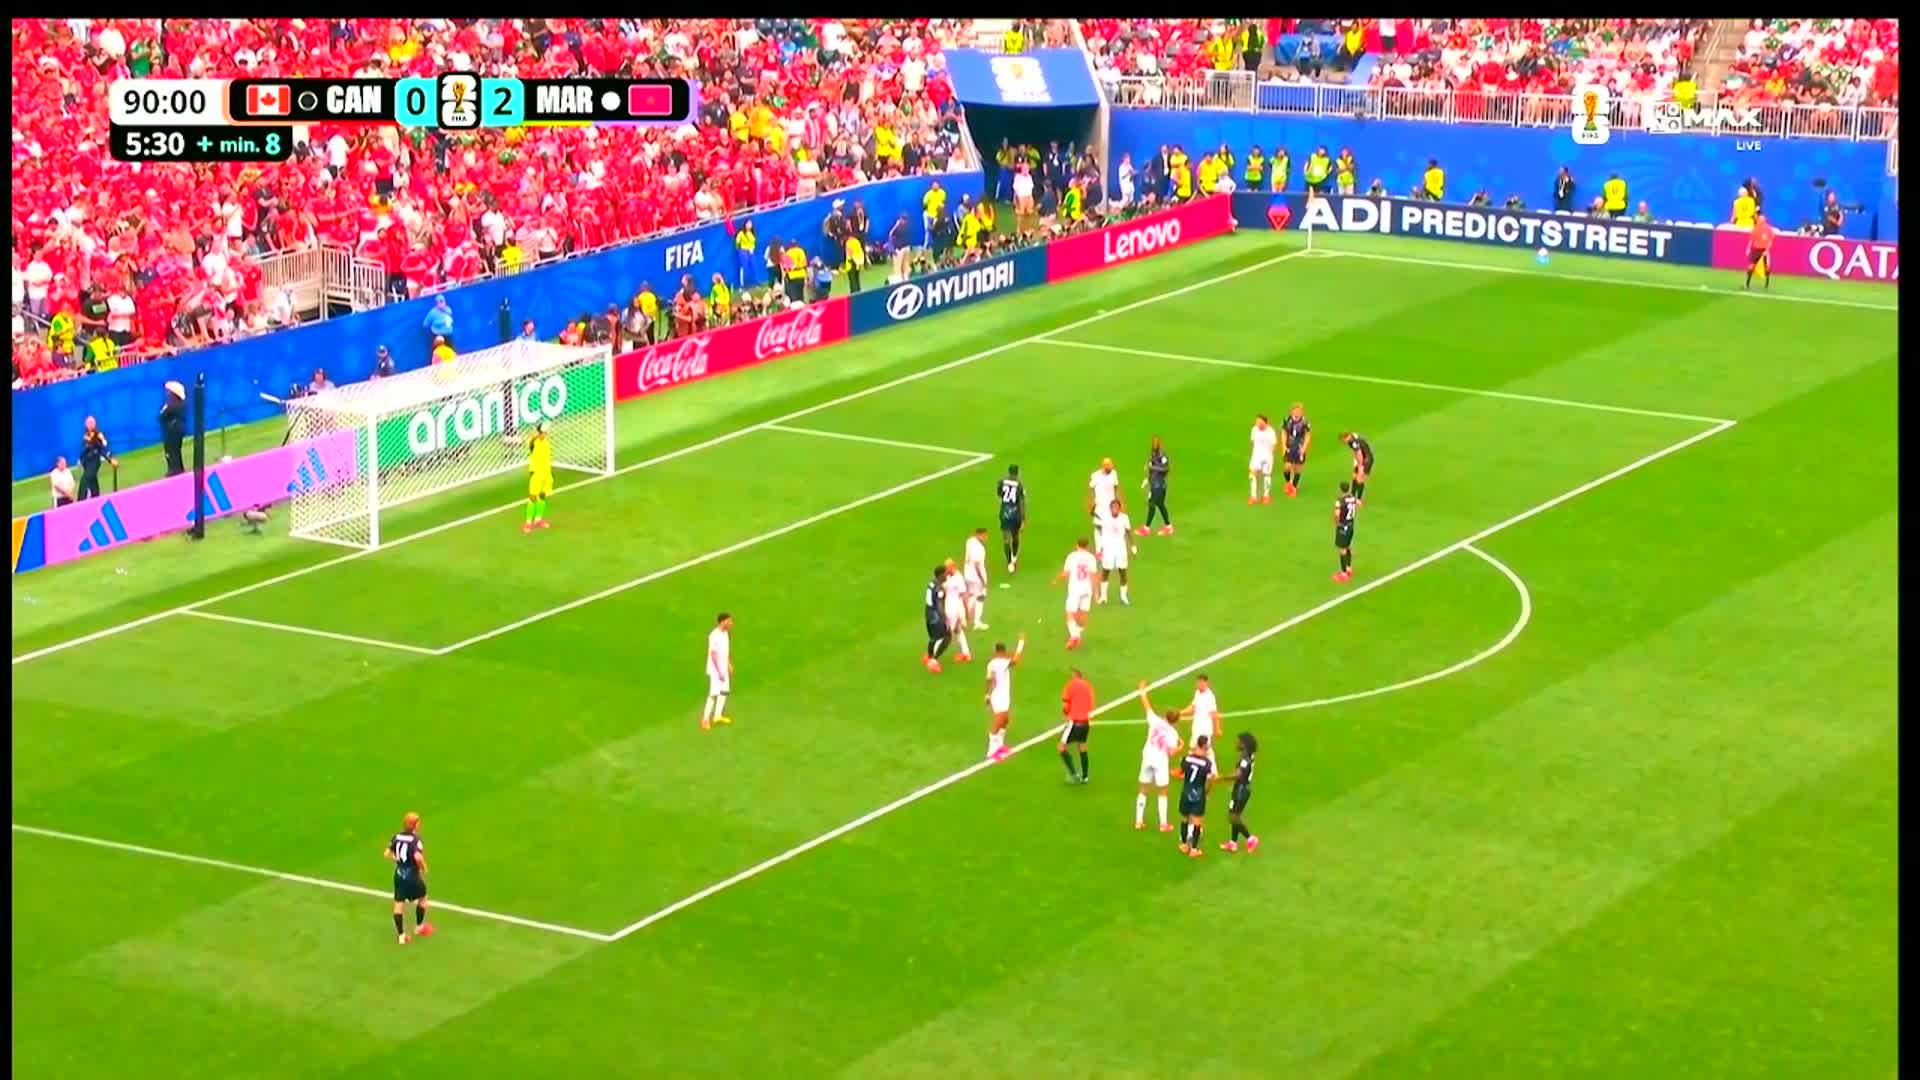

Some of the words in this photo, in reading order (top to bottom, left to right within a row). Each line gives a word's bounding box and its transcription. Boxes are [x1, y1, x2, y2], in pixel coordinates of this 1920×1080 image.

[1104, 218, 1181, 264] Lenovo
[1299, 197, 1392, 233] ADI
[1402, 206, 1673, 258] PREDICTSTREET
[665, 240, 704, 272] FIFA
[1808, 241, 1898, 280] QAT
[926, 260, 1015, 308] HYUNDAI
[1002, 485, 1018, 504] 24
[1189, 764, 1199, 783] 7
